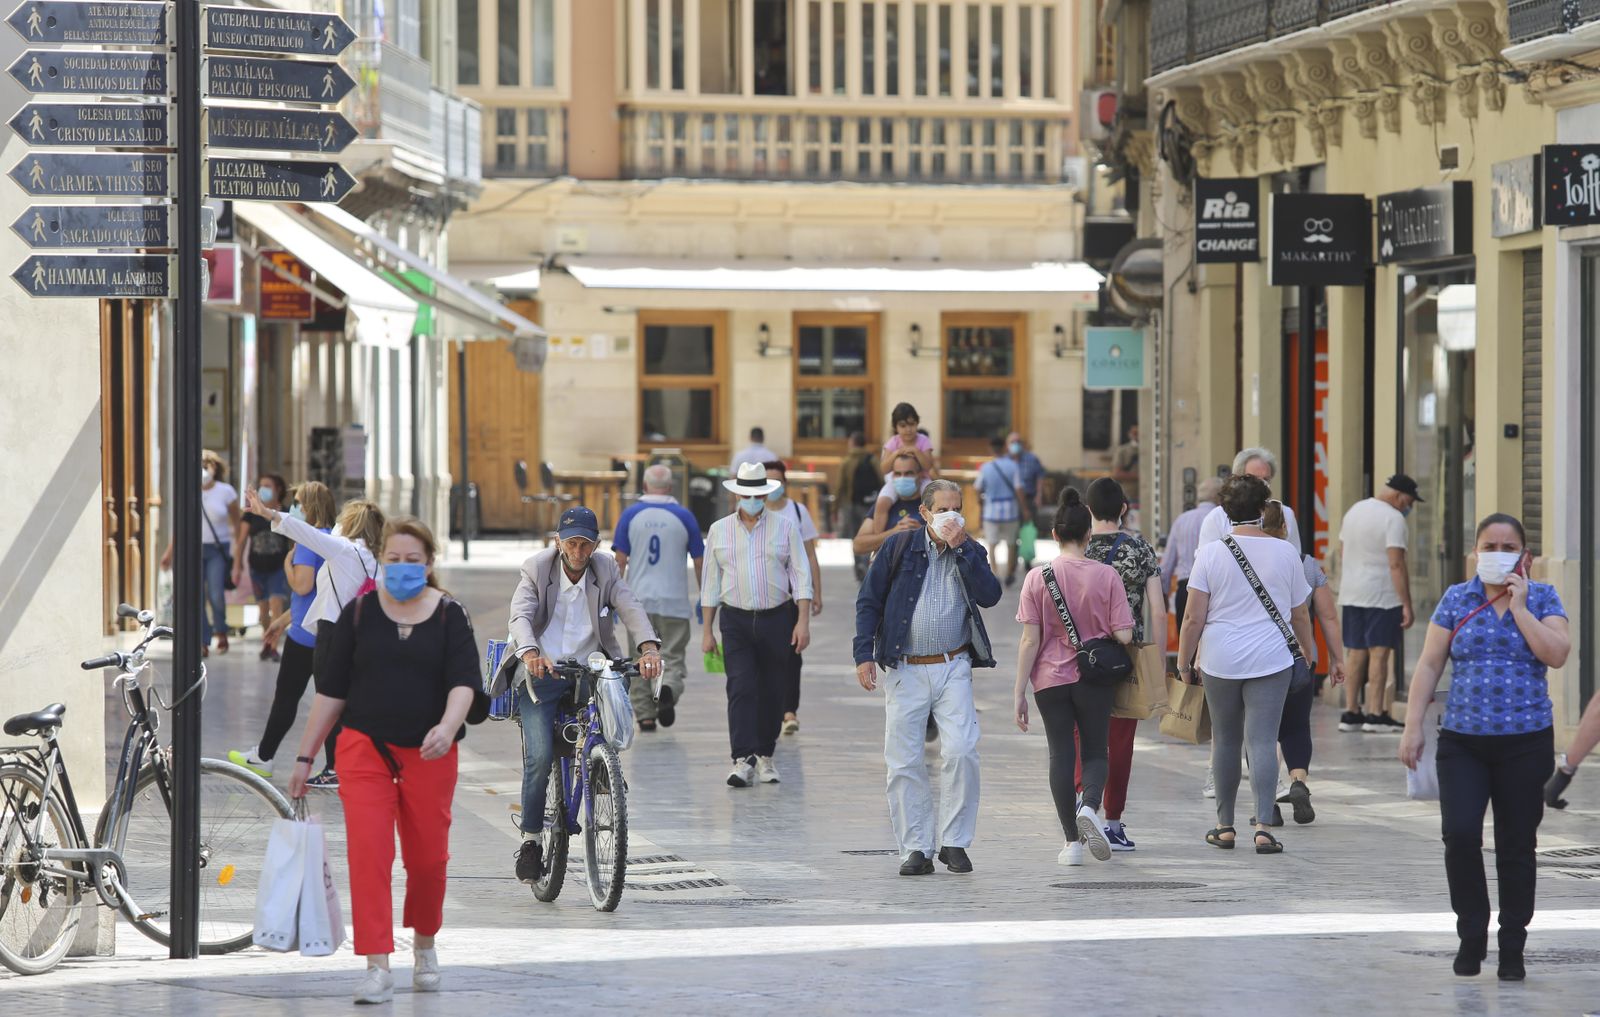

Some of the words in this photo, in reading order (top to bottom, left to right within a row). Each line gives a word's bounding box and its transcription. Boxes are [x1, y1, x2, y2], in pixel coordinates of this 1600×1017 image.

[88, 6, 118, 17] ATENEO
[120, 7, 129, 17] DE
[89, 19, 119, 29] ANTIGUA
[211, 12, 261, 28] CATEDRAL
[264, 16, 276, 29] DE
[277, 16, 312, 31] MÁLAGA
[63, 30, 89, 41] BELLAS
[90, 31, 112, 41] ARTES
[113, 31, 123, 41] DE
[124, 31, 137, 41] SAN
[211, 31, 242, 45] MUSEO
[243, 33, 304, 49] CATEDRALICIO
[63, 57, 108, 70] SOCIEDAD
[110, 56, 161, 71] ECONÓMICA
[211, 64, 232, 78] ARS
[234, 62, 274, 80] MÁLAGA
[63, 75, 77, 89] DE
[79, 76, 117, 90] AMIGOS
[119, 77, 139, 91] DEL
[140, 74, 162, 91] PAÍS
[211, 80, 252, 96] PALACIO
[258, 83, 312, 99] EPISCOPAL
[78, 108, 113, 121] IGLESIA
[115, 109, 132, 121] DEL
[134, 109, 162, 121] SANTO
[57, 127, 96, 142] CRISTO
[98, 127, 112, 142] DE
[114, 128, 127, 142] LA
[129, 127, 162, 142] SALUD
[210, 117, 252, 138] MUSEO
[254, 120, 270, 138] DE
[131, 160, 162, 173] MUSEO
[213, 162, 266, 179] ALCAZABA
[50, 174, 103, 192] CARMEN
[106, 175, 162, 192] THYSSEN
[213, 180, 254, 196] TEATRO
[1202, 191, 1250, 219] Ria
[144, 209, 161, 222] DEL
[63, 228, 111, 243] SAGRADO
[113, 224, 161, 243] CORAZÓN
[1197, 238, 1257, 251] CHANGE
[1281, 251, 1351, 262] MAKARTHY
[48, 268, 106, 285] HAMMAM
[111, 271, 123, 285] AL
[648, 534, 661, 567] 9
